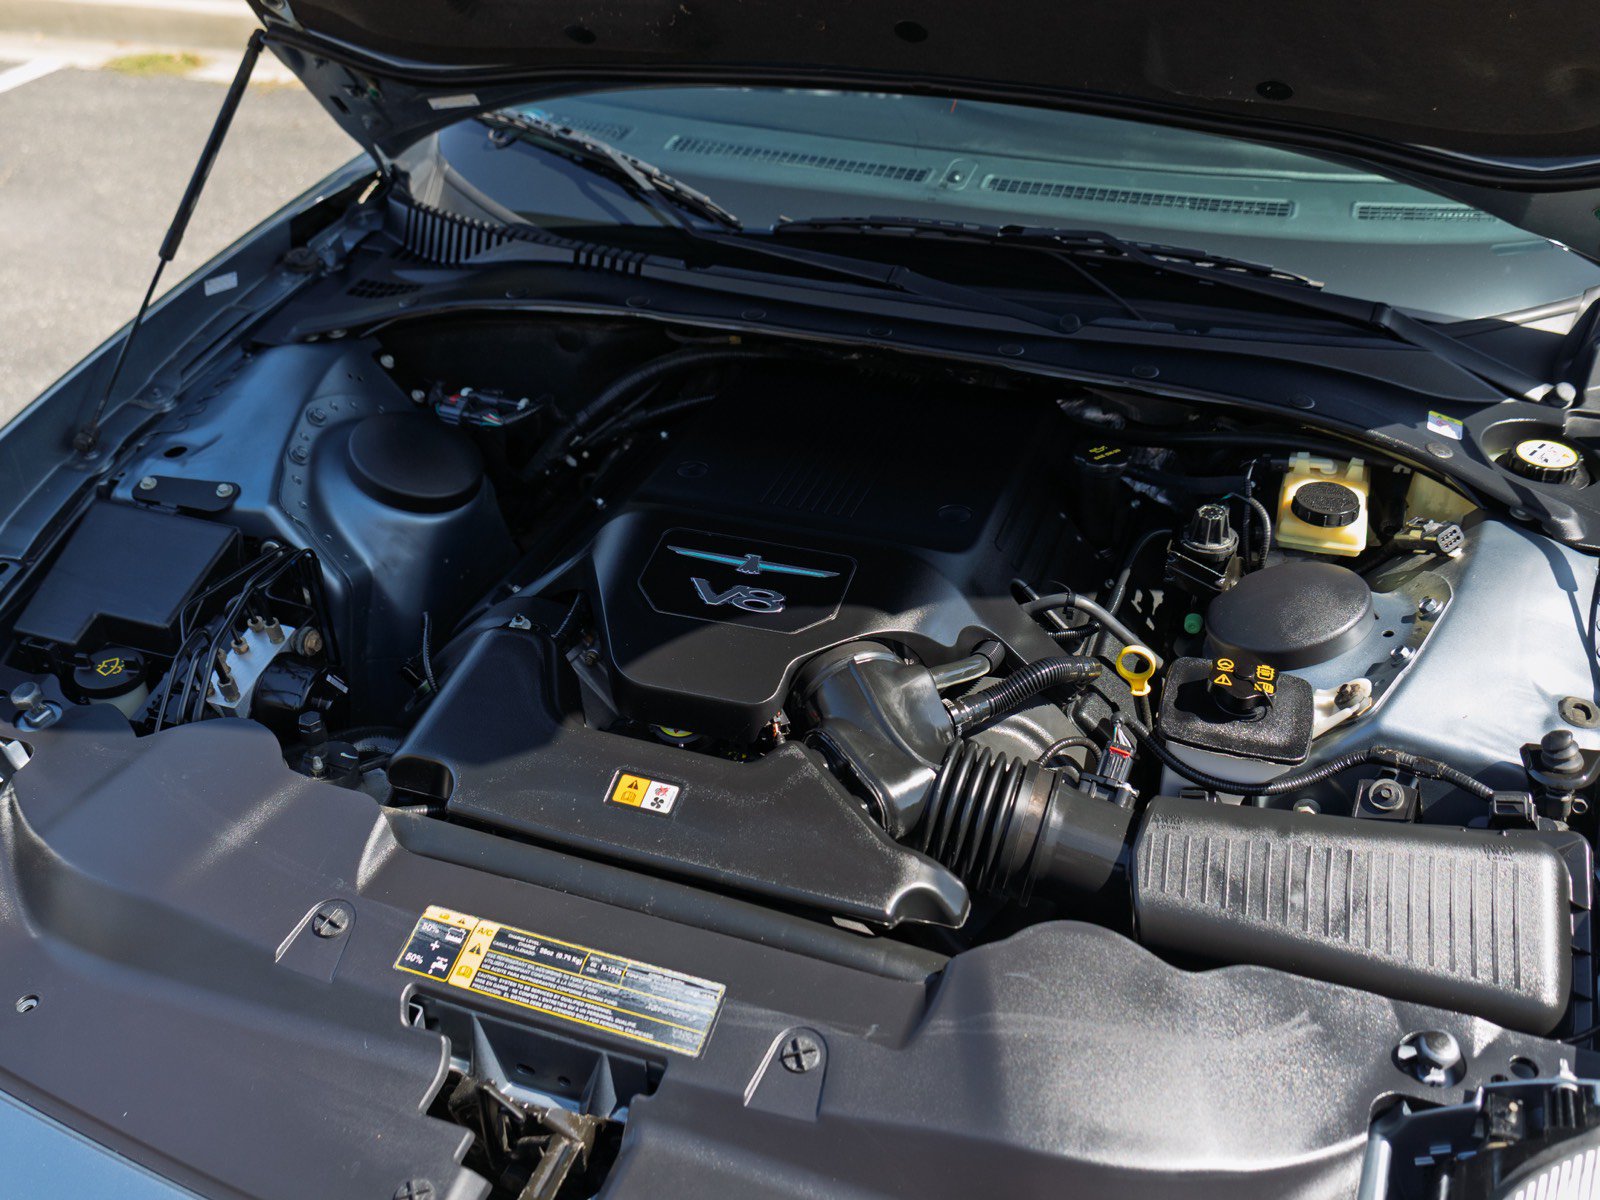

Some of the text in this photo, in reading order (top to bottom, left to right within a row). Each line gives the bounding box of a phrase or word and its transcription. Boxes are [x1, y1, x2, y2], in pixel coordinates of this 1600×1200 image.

[689, 576, 787, 613] V8
[421, 922, 440, 933] 50%
[478, 927, 494, 936] A/C
[508, 933, 526, 941] CHARGE
[405, 952, 423, 964] 50%
[571, 956, 582, 965] Kg)
